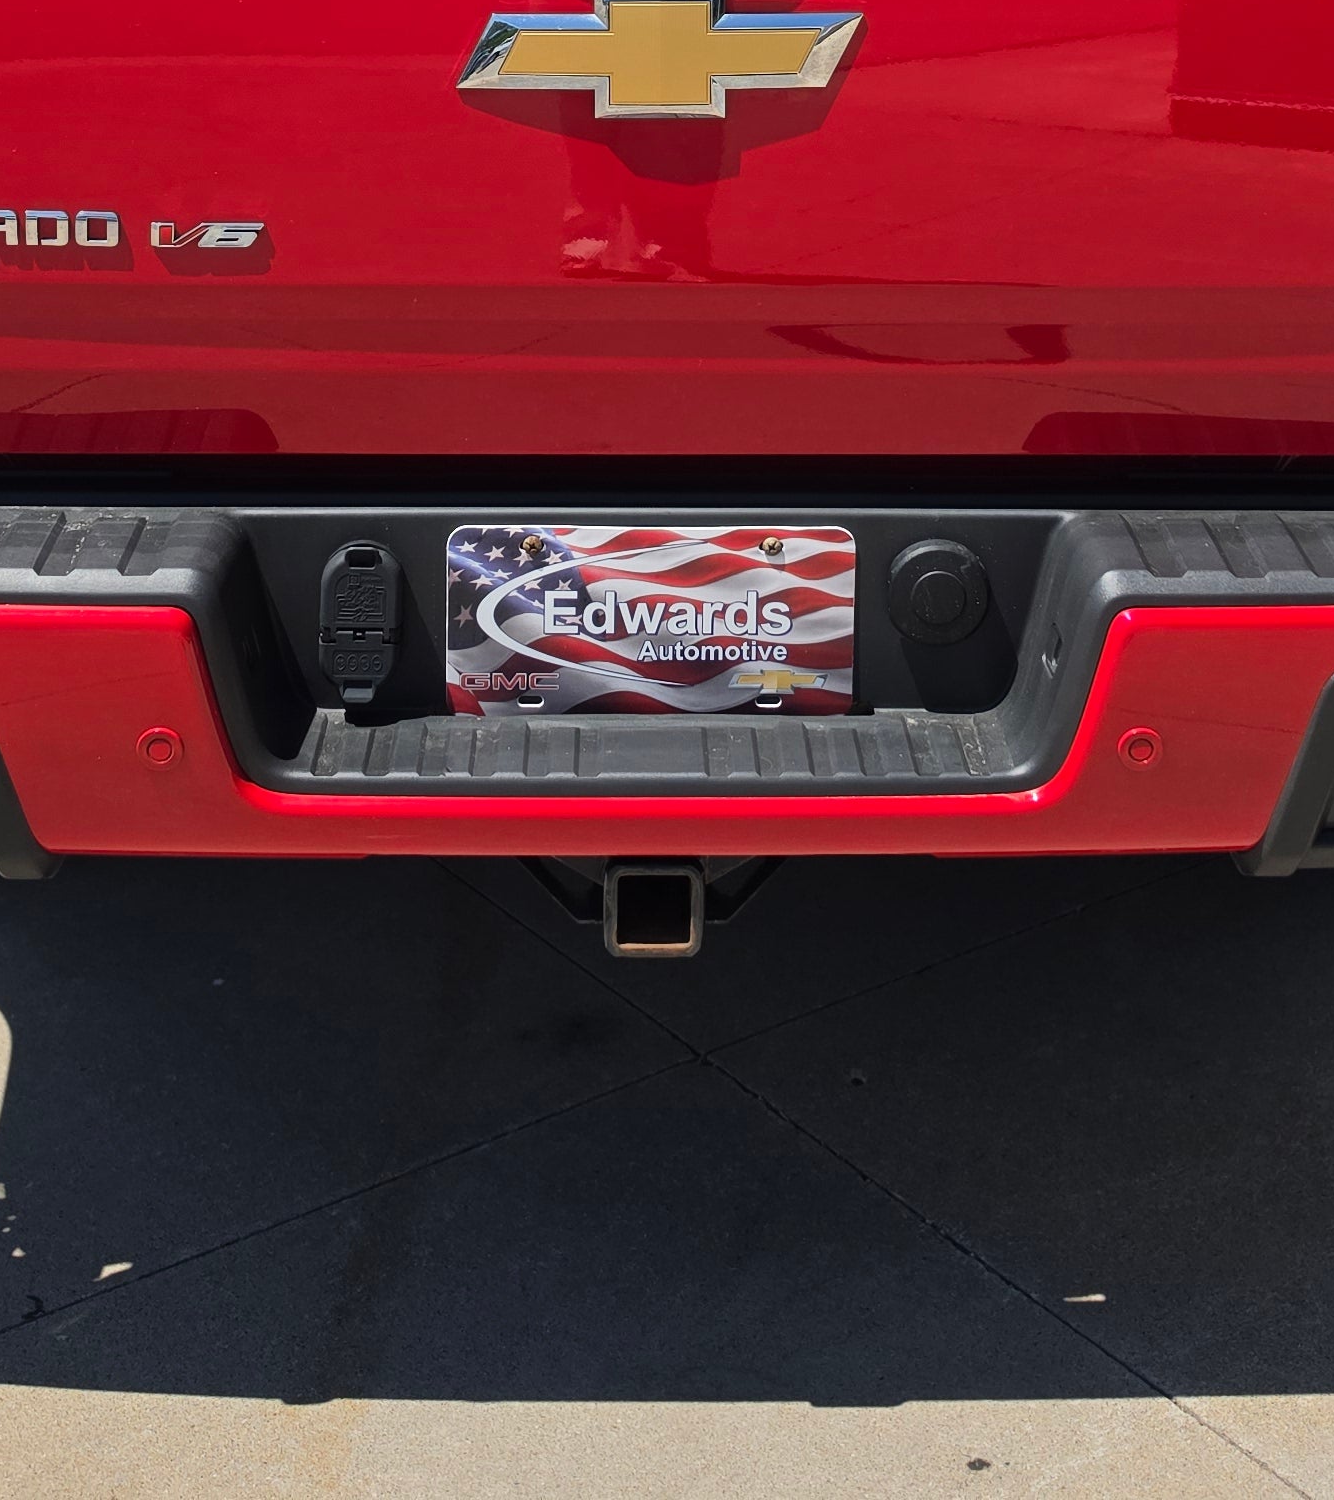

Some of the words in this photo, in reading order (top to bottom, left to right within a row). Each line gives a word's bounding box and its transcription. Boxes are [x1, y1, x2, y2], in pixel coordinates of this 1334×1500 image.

[151, 221, 265, 249] V6
[542, 589, 793, 636] Edwards
[637, 640, 788, 662] Automotive
[459, 672, 561, 691] GMC
